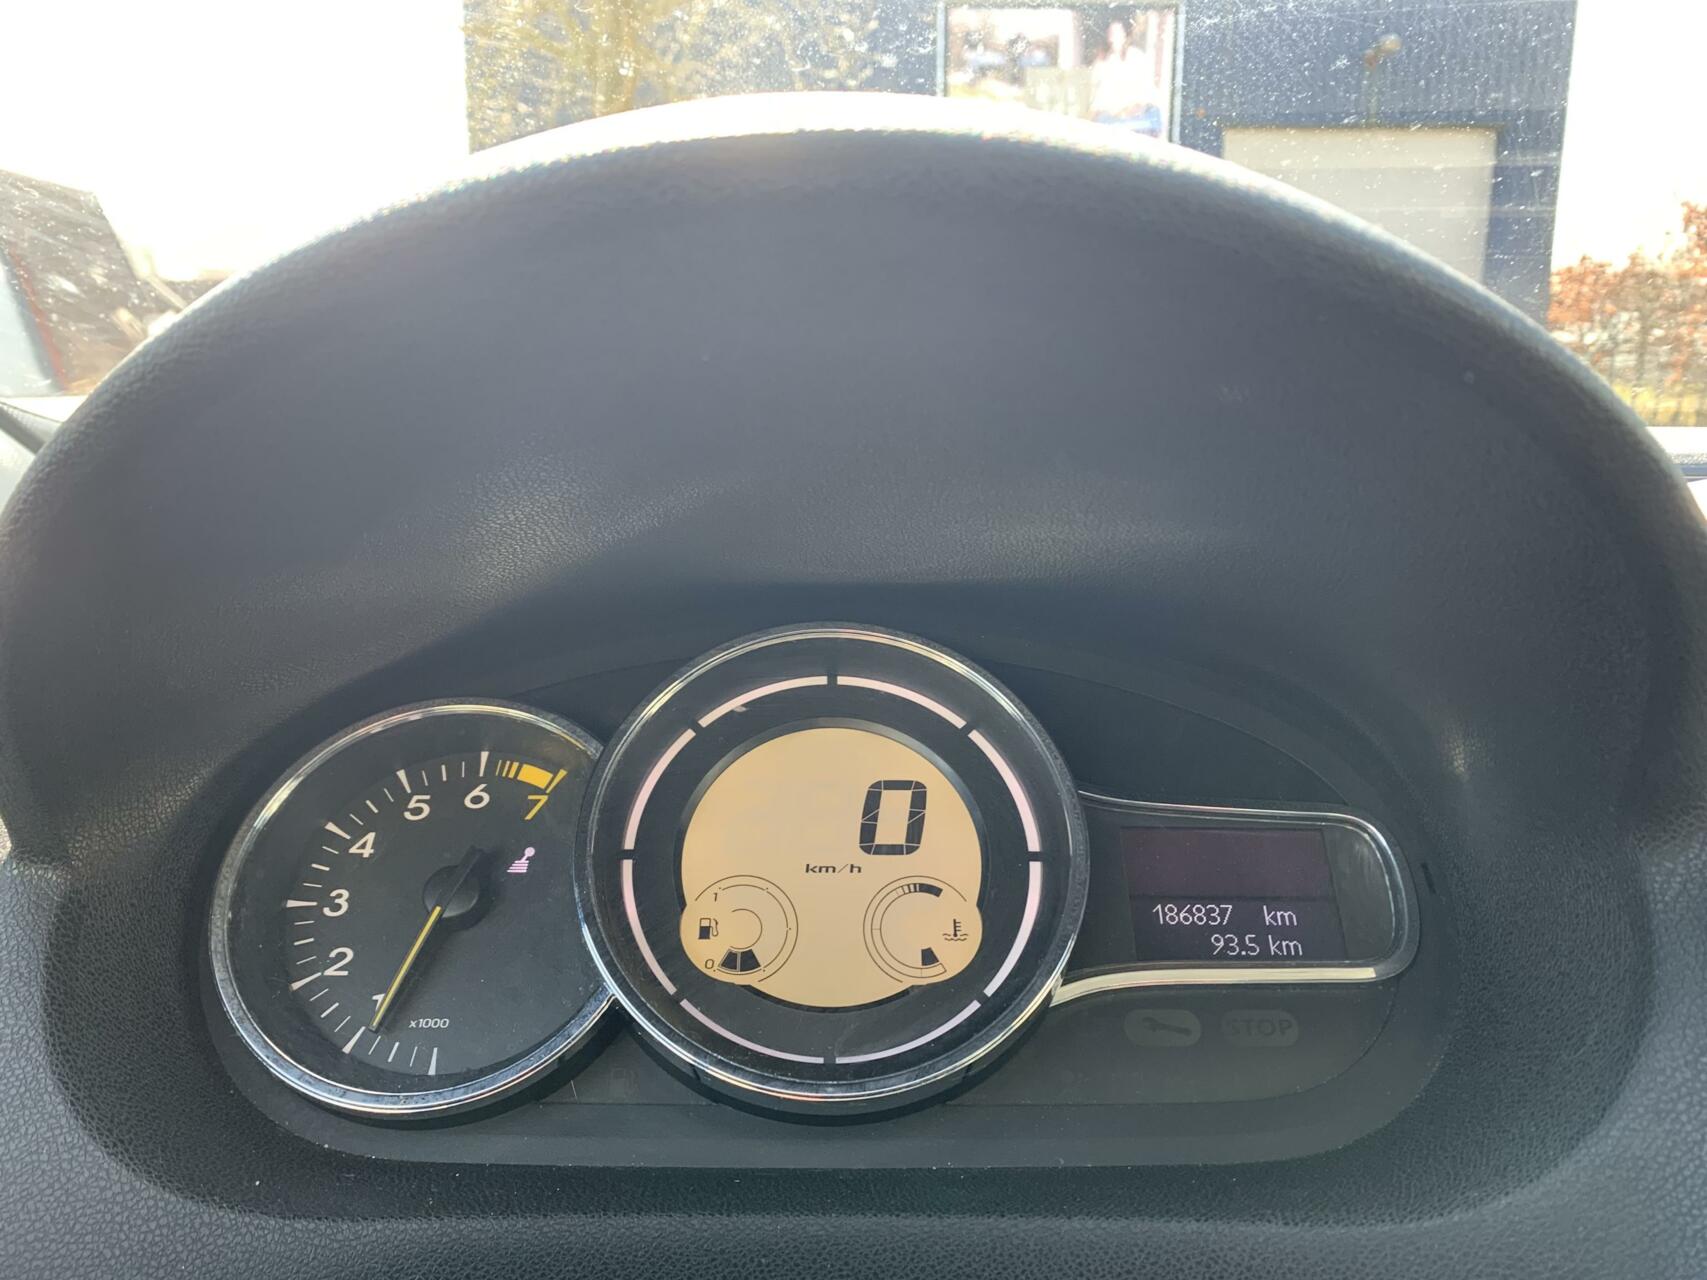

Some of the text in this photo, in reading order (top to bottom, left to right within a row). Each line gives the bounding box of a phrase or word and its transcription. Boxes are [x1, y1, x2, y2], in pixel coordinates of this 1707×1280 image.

[404, 795, 430, 821] 5
[464, 783, 490, 809] 6
[524, 795, 549, 820] 7
[859, 780, 927, 855] 0
[348, 832, 376, 858] 4
[805, 863, 862, 874] km/h
[322, 889, 350, 917] 3
[1152, 904, 1298, 926] 186837 km
[1210, 935, 1303, 956] 93.5 km
[323, 947, 354, 976] 2
[408, 1018, 449, 1029] x1000
[1230, 1018, 1293, 1037] STOP
